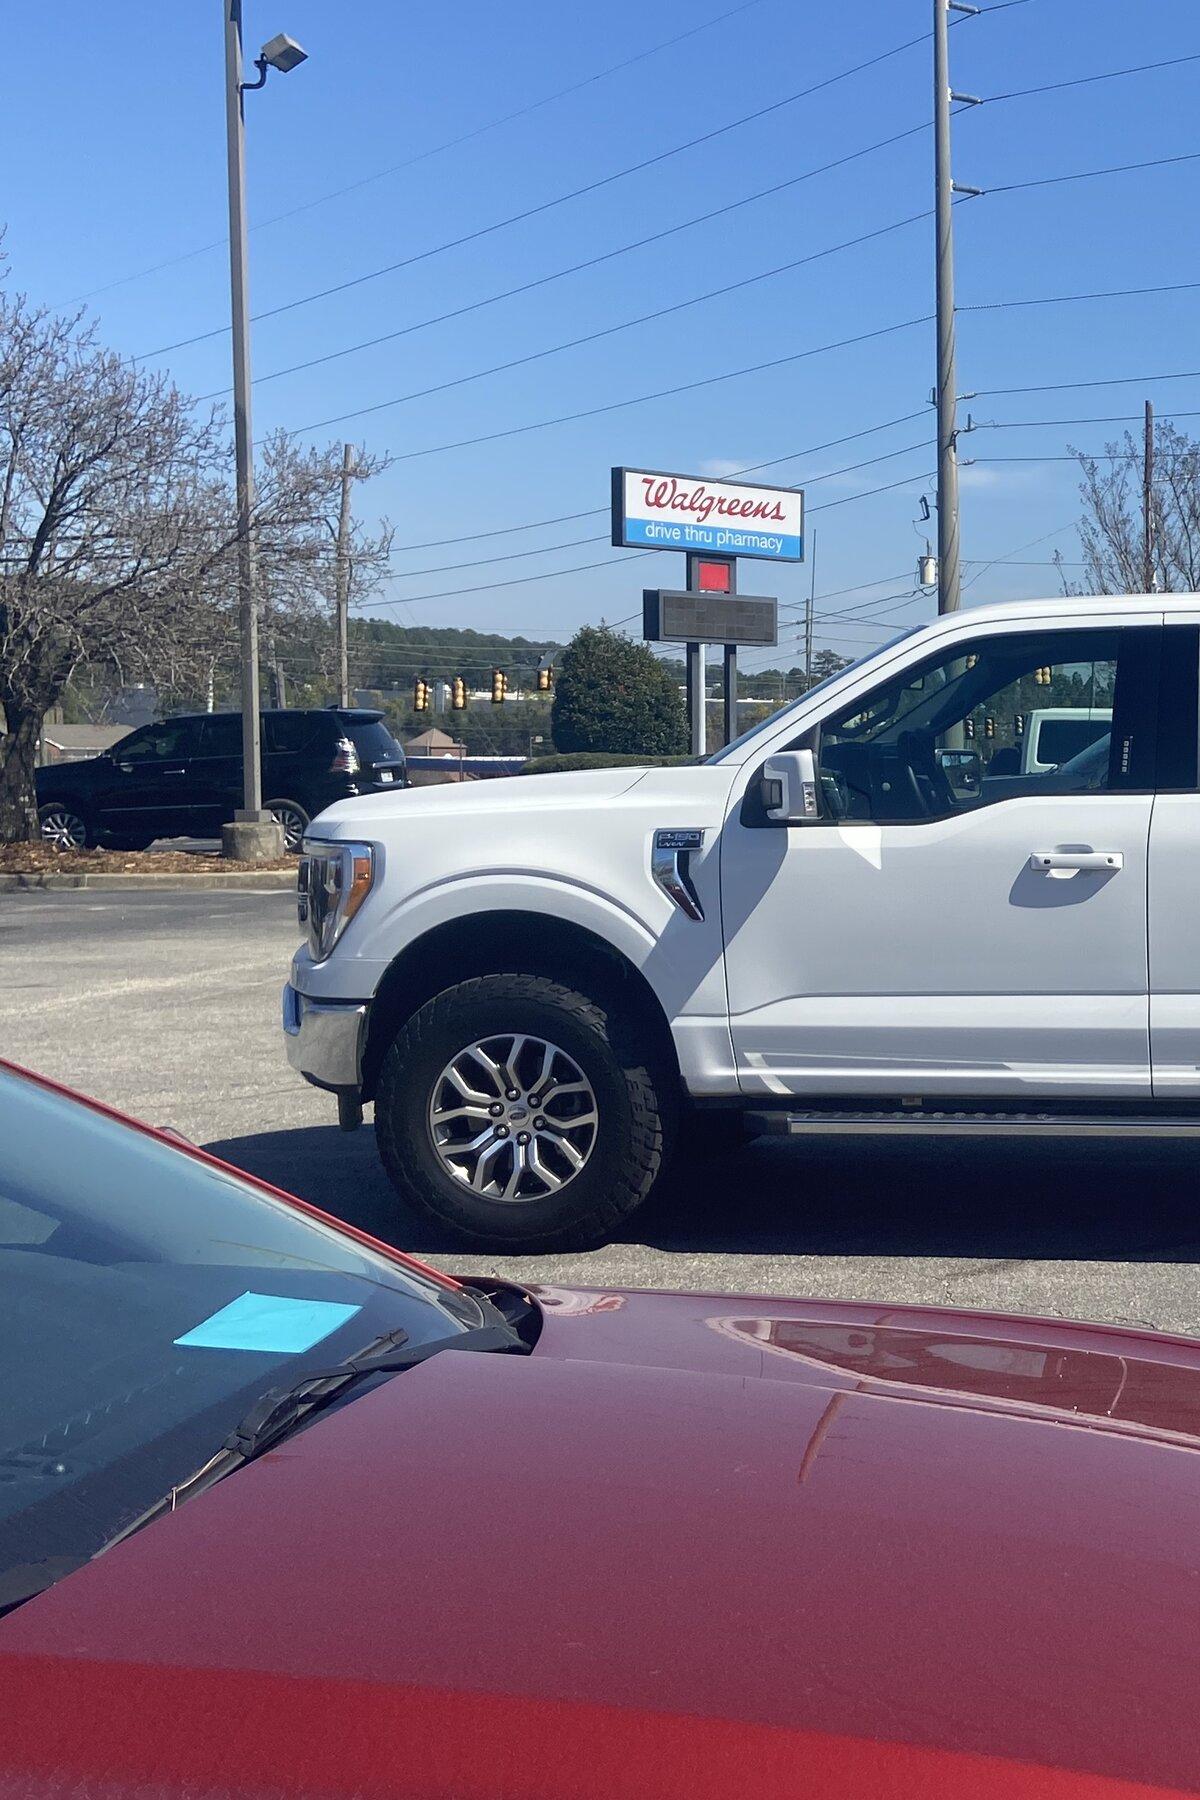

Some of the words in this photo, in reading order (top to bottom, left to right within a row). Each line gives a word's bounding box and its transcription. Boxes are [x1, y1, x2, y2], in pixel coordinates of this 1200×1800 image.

[642, 477, 786, 523] Walgreens
[645, 522, 681, 540] drive
[685, 525, 713, 543] thru
[717, 529, 783, 554] pharmacy
